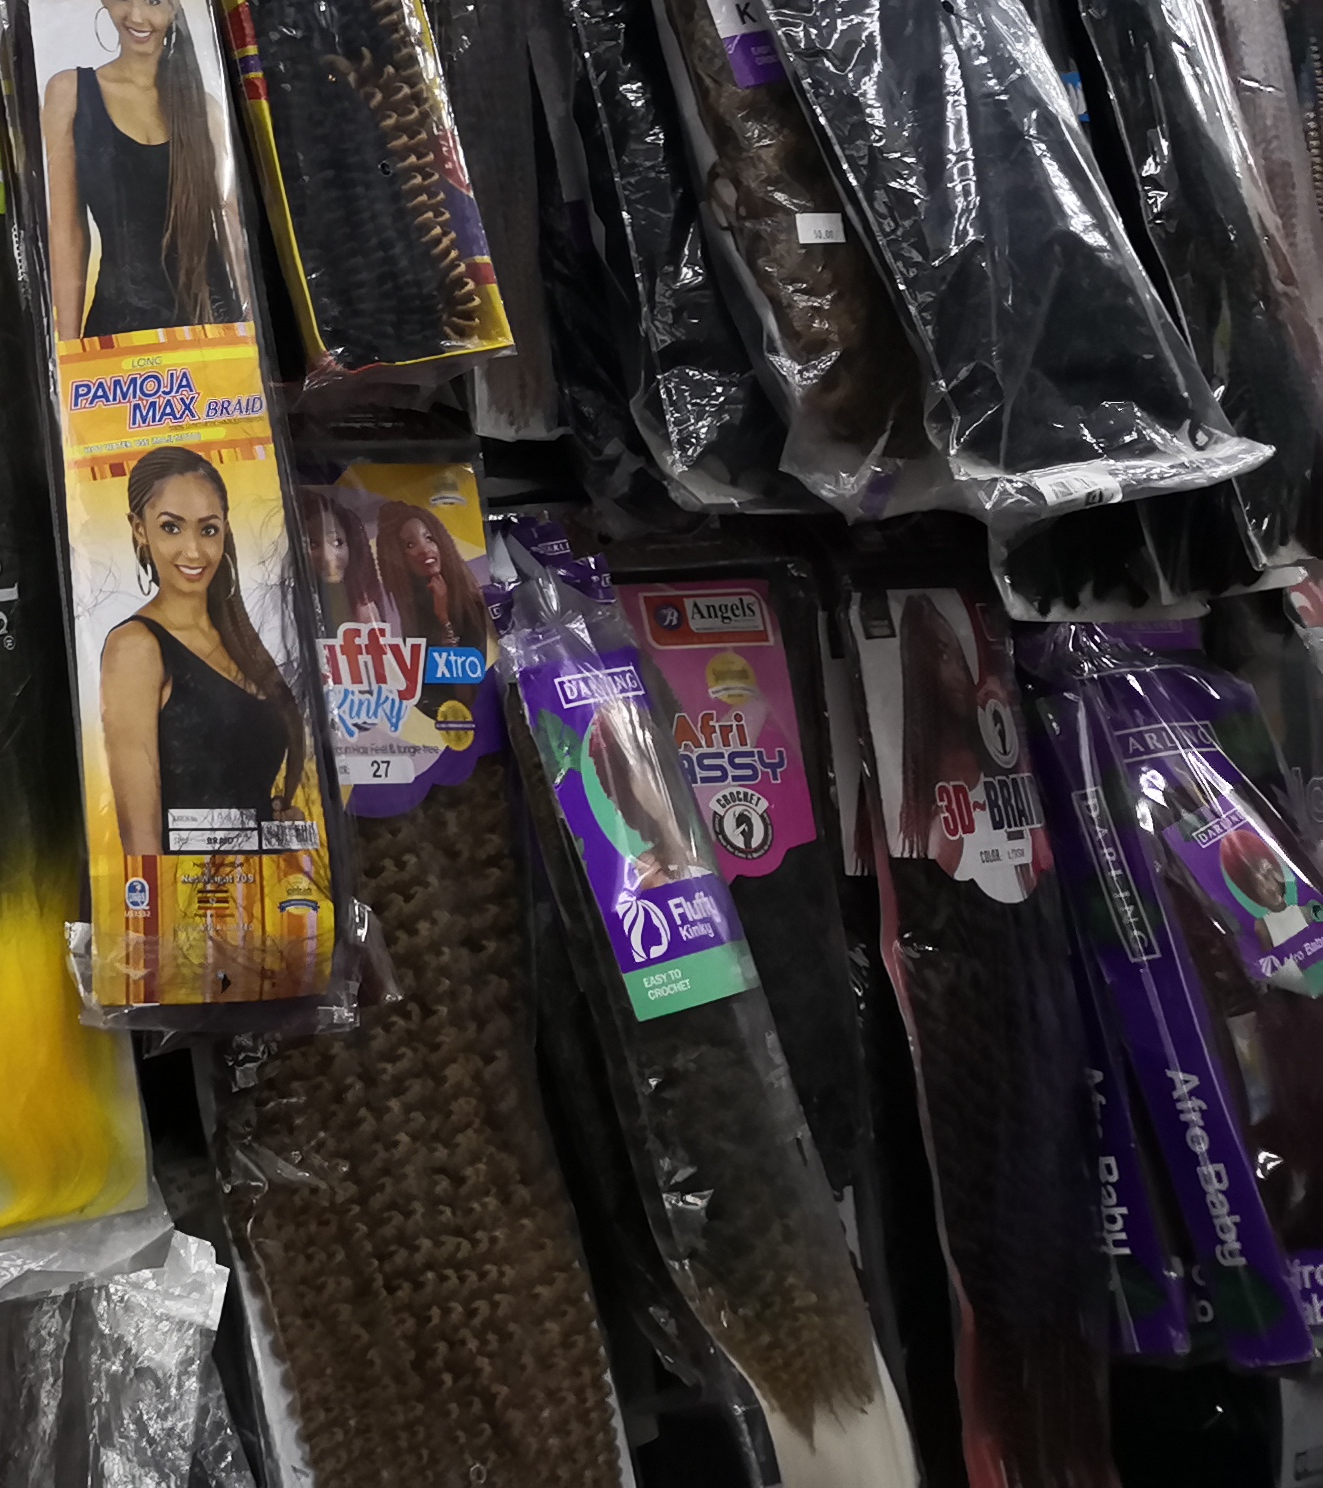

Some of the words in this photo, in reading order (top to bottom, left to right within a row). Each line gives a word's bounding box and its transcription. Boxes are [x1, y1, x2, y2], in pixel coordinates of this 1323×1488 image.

[70, 368, 196, 411] PAMOJA
[127, 392, 202, 432] MAX
[203, 394, 265, 420] BRAID
[690, 597, 756, 625] Angels
[432, 651, 482, 679] Xtra
[672, 711, 751, 752] Afri
[370, 760, 391, 780] 27
[714, 786, 763, 810] CROCHET
[666, 892, 721, 928] Fluffy
[677, 922, 716, 943] Kinky
[642, 973, 667, 989] EASY
[668, 968, 683, 982] TO
[647, 978, 692, 1001] CROCHET
[1165, 1068, 1210, 1155] Afro
[1197, 1162, 1248, 1268] Baby
